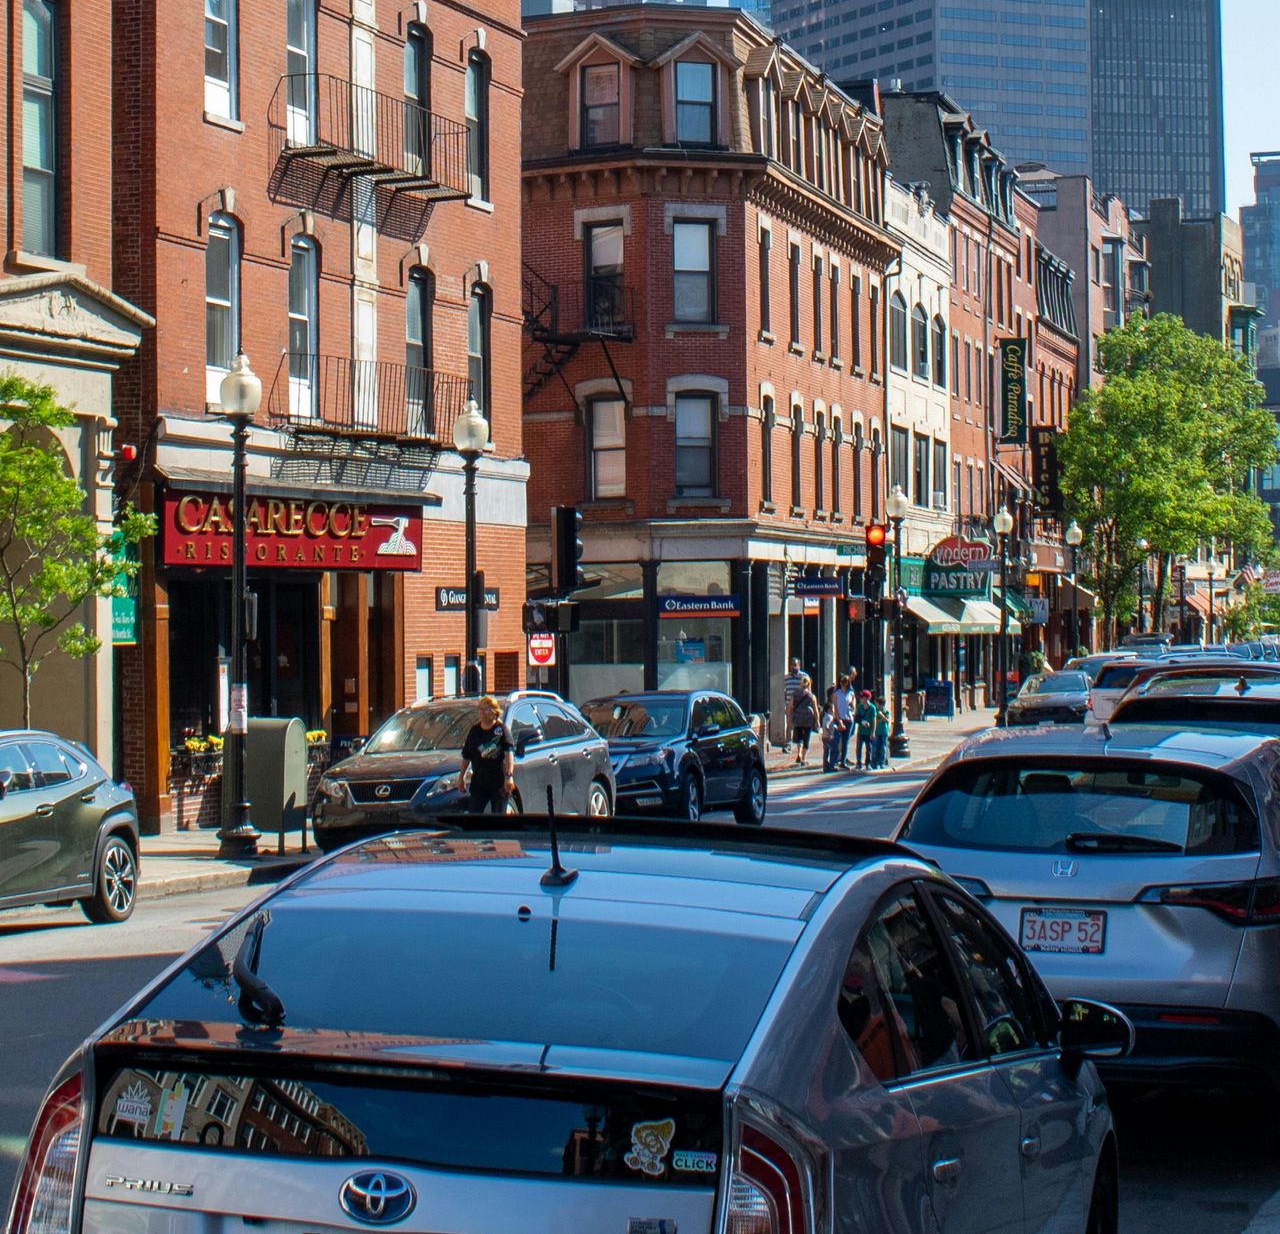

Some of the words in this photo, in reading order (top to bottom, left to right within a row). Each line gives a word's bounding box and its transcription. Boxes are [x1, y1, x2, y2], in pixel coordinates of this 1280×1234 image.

[1007, 382, 1023, 437] Paradiso
[185, 542, 360, 562] RISORANTE
[930, 572, 985, 589] PASTRY
[676, 601, 710, 610] Eastern
[711, 600, 734, 609] Bank
[1025, 919, 1072, 941] 3ASP
[1078, 921, 1100, 943] 52
[118, 1103, 150, 1117] wana
[674, 1157, 716, 1171] CLICK
[105, 1174, 194, 1196] PRIUS
